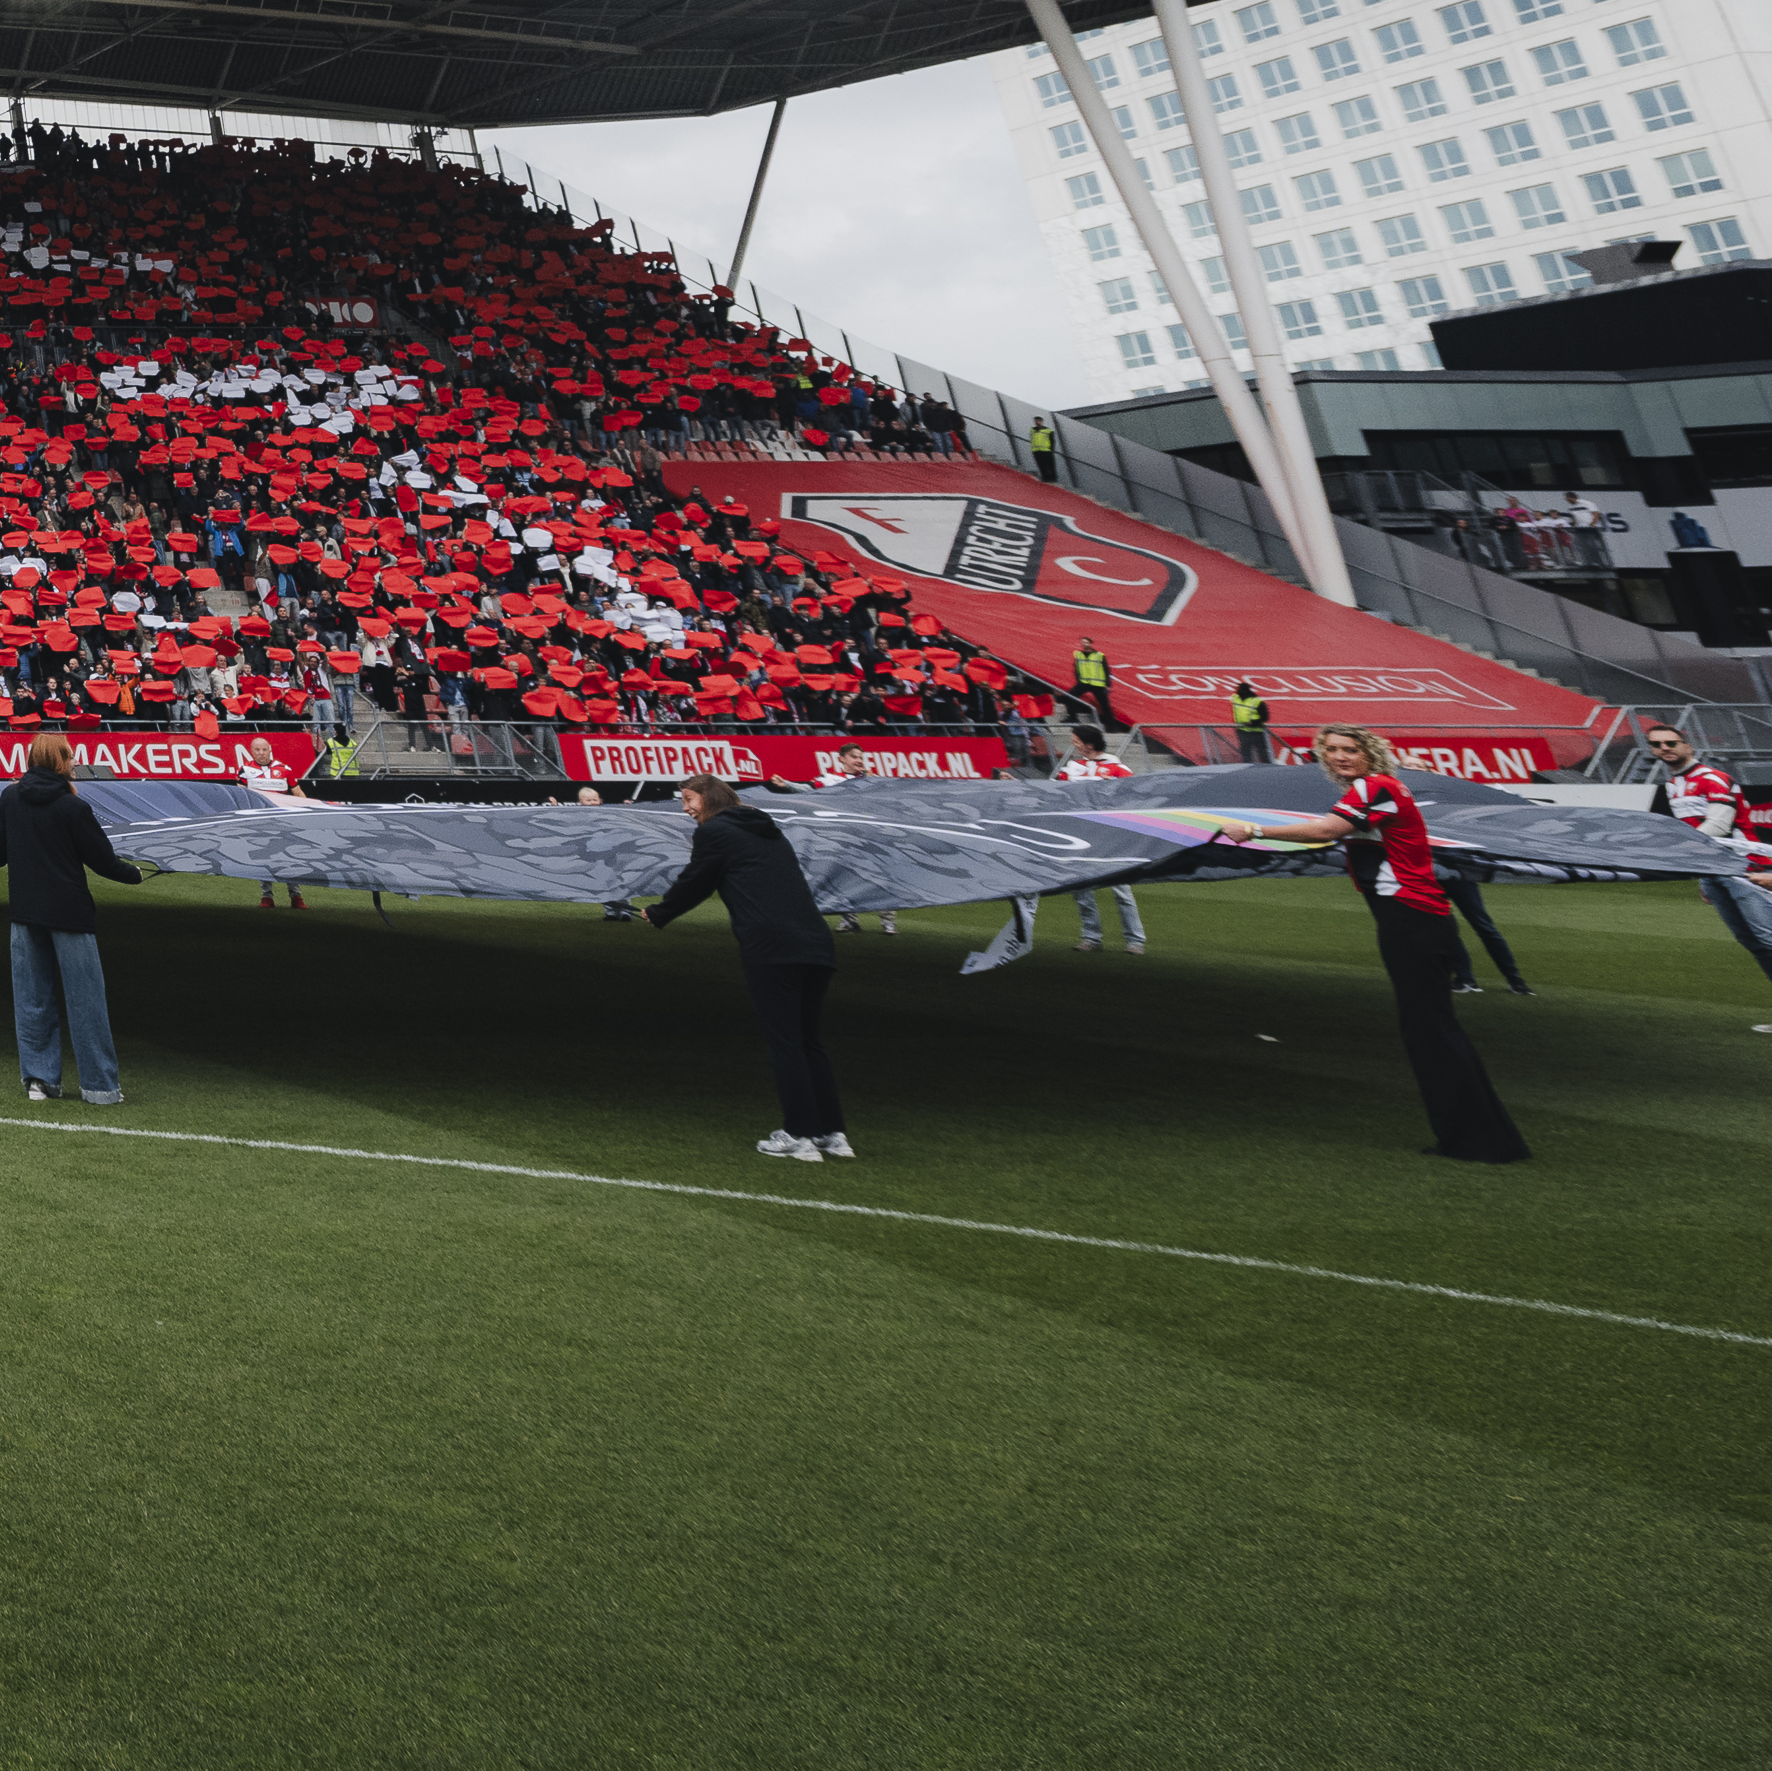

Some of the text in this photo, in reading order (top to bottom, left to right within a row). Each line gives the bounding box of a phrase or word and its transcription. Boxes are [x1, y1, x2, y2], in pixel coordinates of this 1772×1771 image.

[954, 504, 1039, 591] UTRECHT
[1136, 674, 1466, 699] CONCLUSION
[592, 745, 732, 776] PROFIPACK
[815, 752, 982, 778] PRFIPACK.NL
